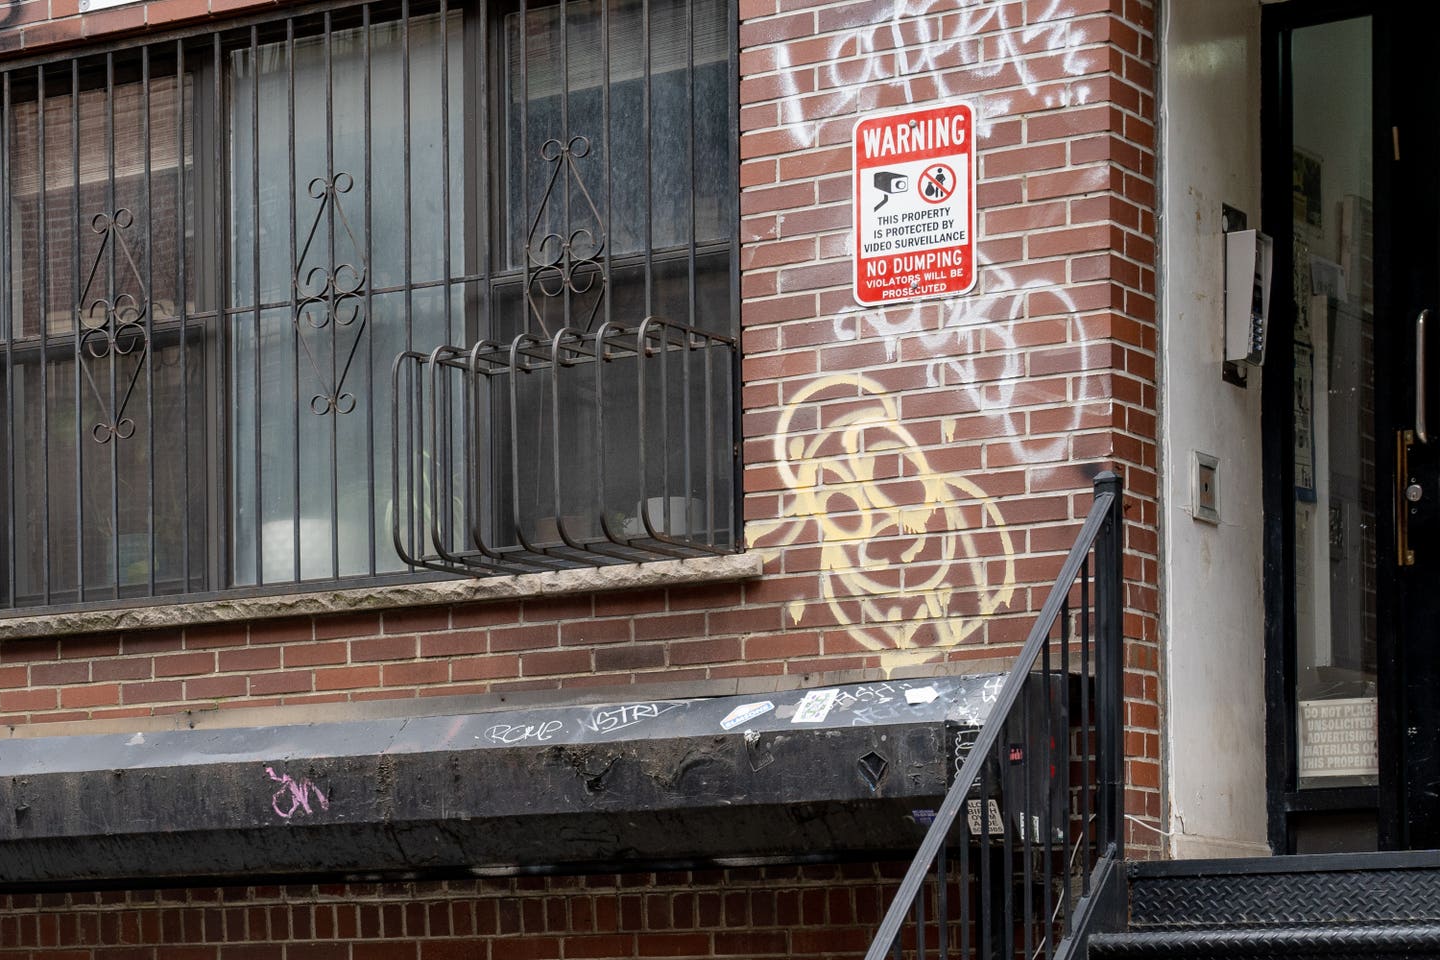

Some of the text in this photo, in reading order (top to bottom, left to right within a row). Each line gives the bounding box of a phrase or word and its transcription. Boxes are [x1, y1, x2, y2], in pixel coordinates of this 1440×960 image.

[863, 114, 965, 159] WARNING
[877, 207, 951, 226] THIS PROPERTY
[873, 219, 954, 239] IS PROTECTED BY
[864, 230, 965, 253] VIDEO SURVEILLANCE
[867, 249, 962, 277] NO DUMPING
[866, 268, 964, 289] VIOLATORS WILL BE
[882, 283, 947, 299] PROSECUTED
[1304, 704, 1377, 719] DO NOT PLACE
[1308, 718, 1373, 731] UNSOLICITED
[1308, 730, 1374, 744] ADVERTISING
[1304, 743, 1360, 757] MATERIALS
[1304, 757, 1324, 769] THIS
